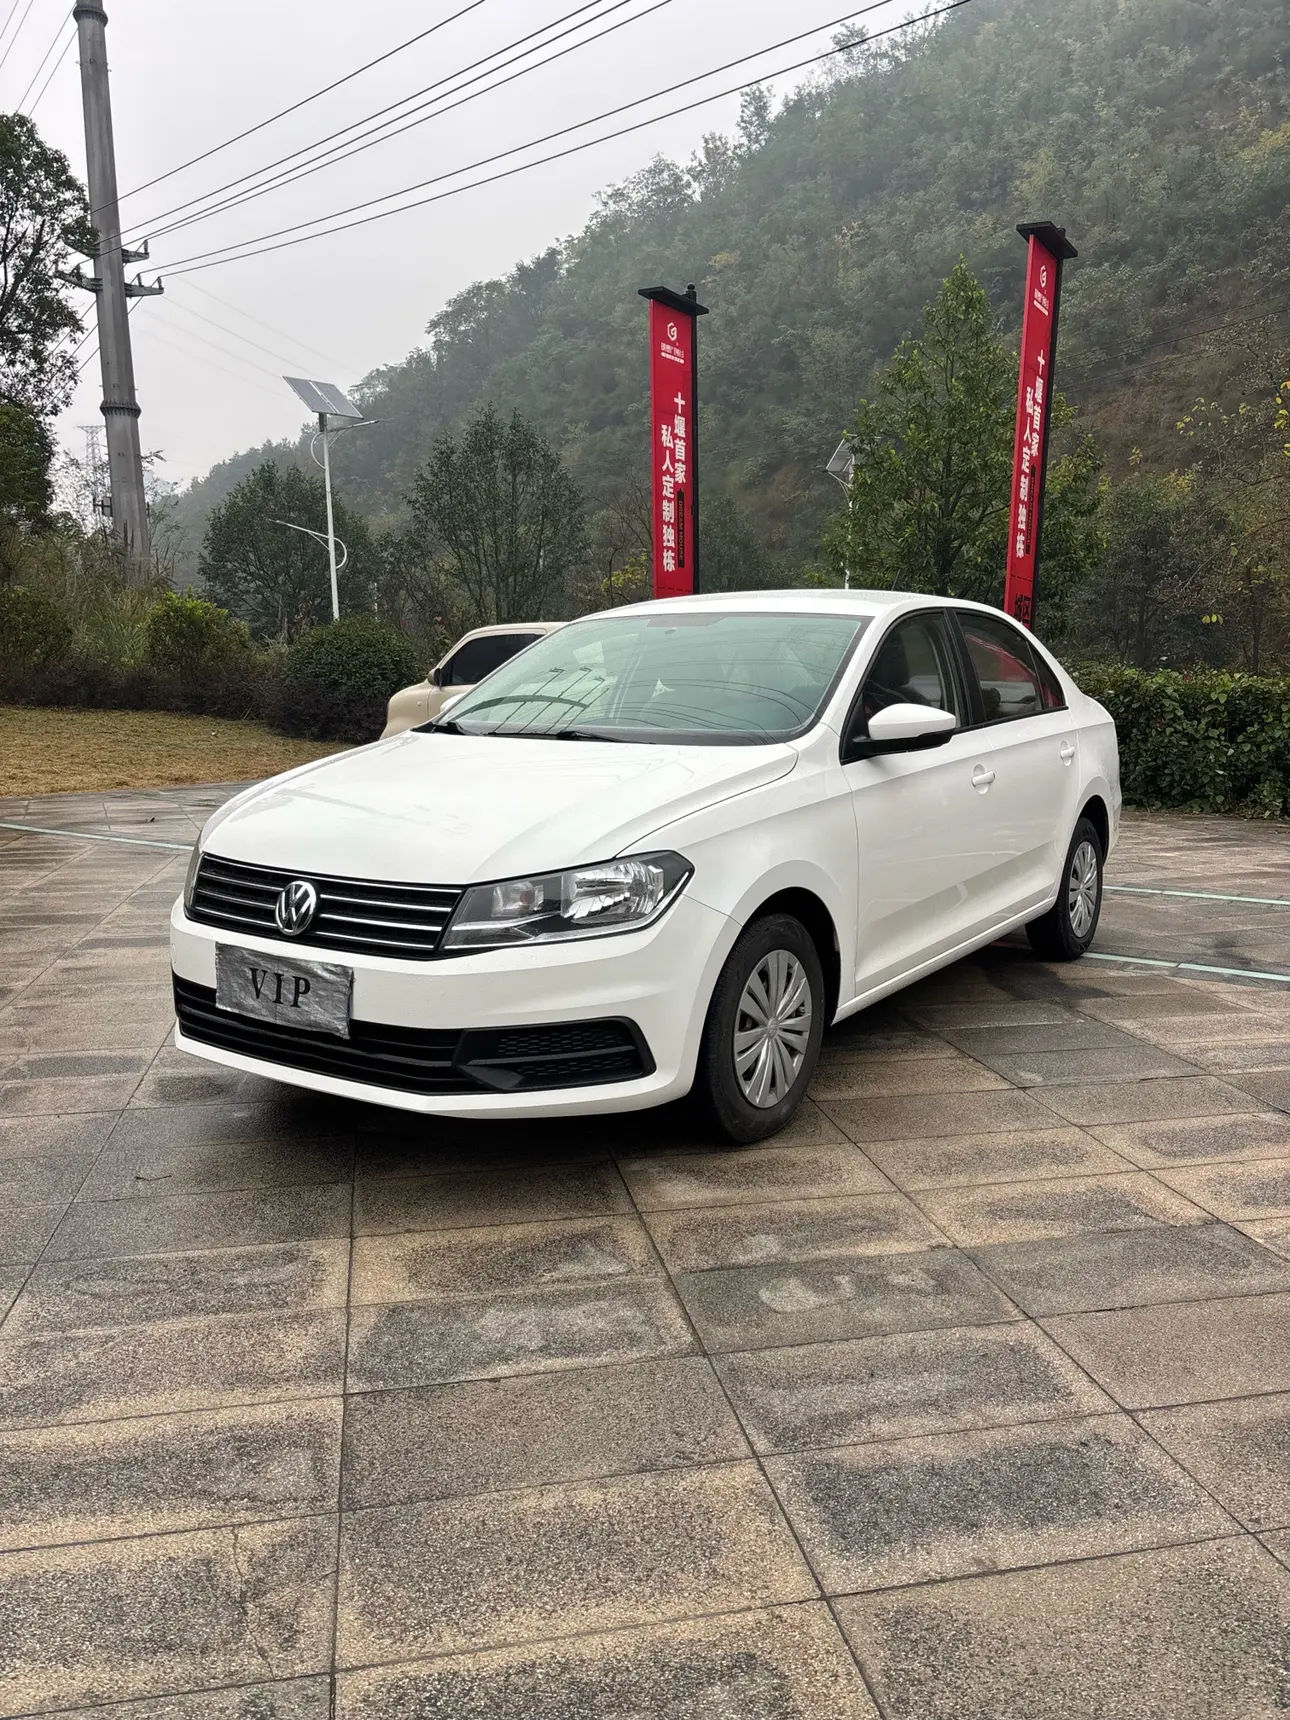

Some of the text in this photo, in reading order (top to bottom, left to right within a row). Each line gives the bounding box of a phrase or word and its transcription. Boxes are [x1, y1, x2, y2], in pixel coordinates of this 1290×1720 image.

[674, 391, 686, 483] 十堰首家
[1030, 349, 1046, 457] 十堰首家
[661, 424, 675, 572] 私人定制独栋
[1016, 386, 1034, 558] 私人定制独栋
[249, 967, 311, 1009] VIP
